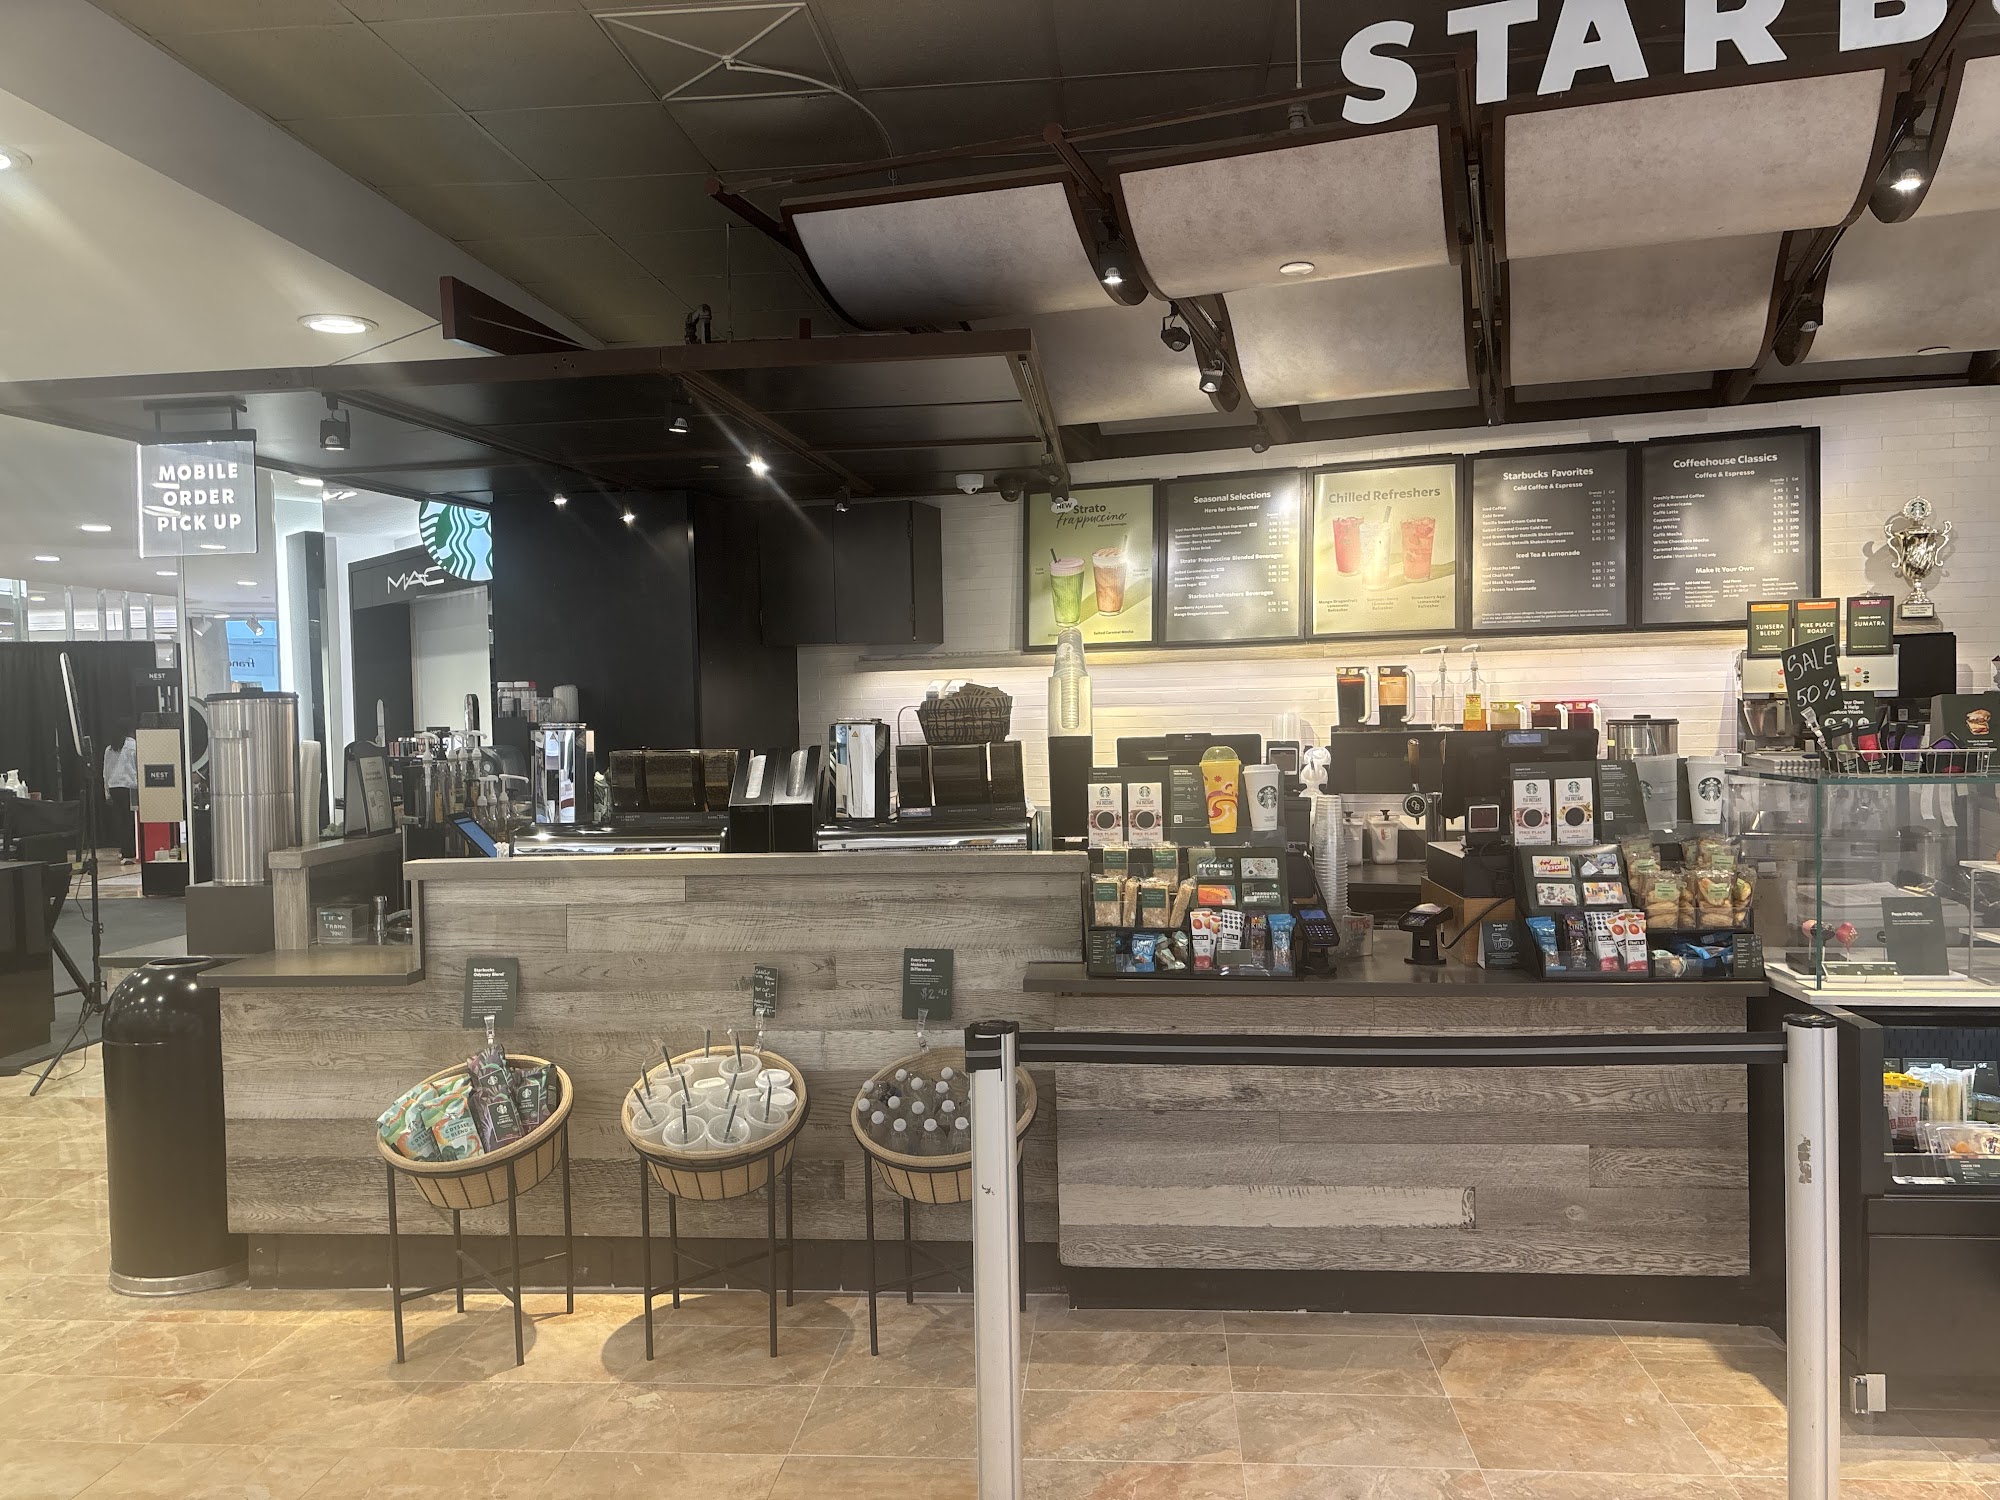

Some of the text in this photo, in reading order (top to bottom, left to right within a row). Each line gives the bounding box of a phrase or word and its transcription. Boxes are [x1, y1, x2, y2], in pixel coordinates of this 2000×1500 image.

[1340, 0, 2000, 126] STARB
[1673, 454, 1778, 468] Coffeehouse Classics
[159, 463, 238, 480] MOBILE
[1503, 468, 1593, 480] Starbucks Favorites
[163, 488, 234, 506] ORDER
[1193, 491, 1271, 504] Seasonal Selections
[1329, 488, 1440, 503] Chilled Refreshers
[1073, 505, 1106, 514] Strato
[157, 513, 241, 532] PICK UP
[1056, 512, 1127, 529] Frappuccino
[1788, 644, 1835, 680] SALE
[1797, 678, 1836, 707] 50%
